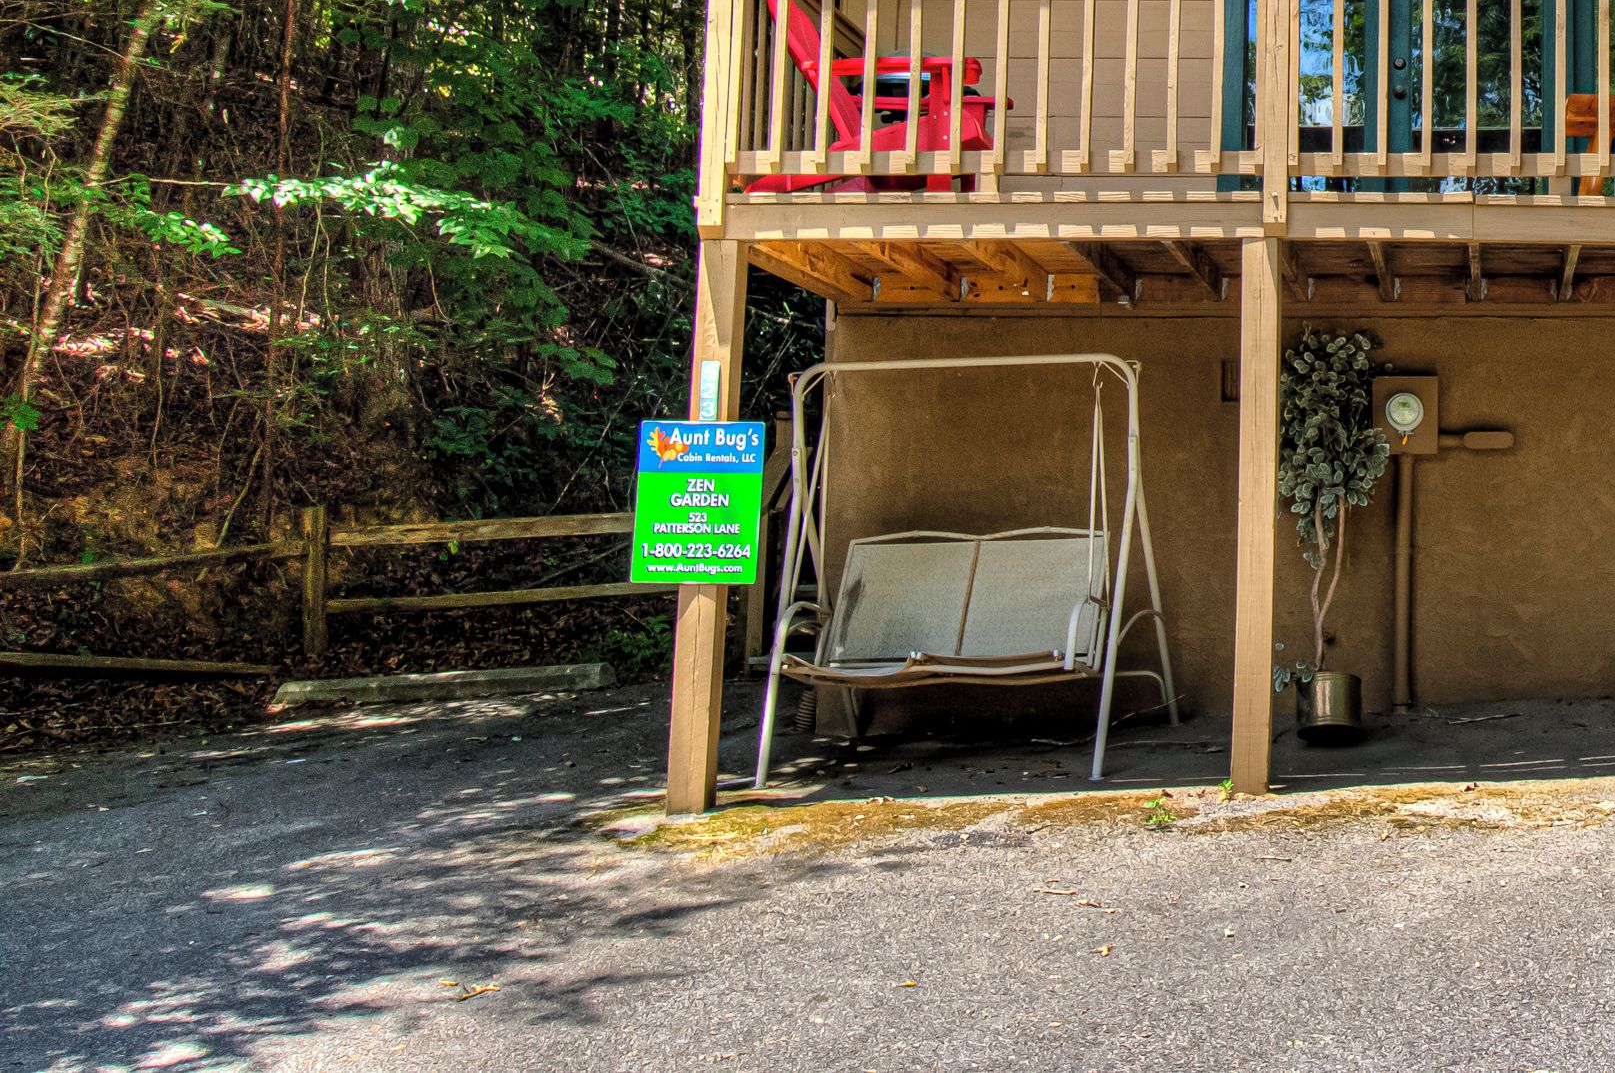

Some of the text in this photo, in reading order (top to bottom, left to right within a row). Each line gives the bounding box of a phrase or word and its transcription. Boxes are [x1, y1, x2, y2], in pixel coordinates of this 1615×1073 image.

[669, 427, 759, 451] Aunt Bug's
[677, 452, 757, 464] Cabin Rentals, LLC
[686, 478, 715, 493] ZEN
[670, 493, 730, 508] GARDEN
[688, 512, 708, 523] 523
[653, 523, 740, 534] PATTERSON LANE
[642, 542, 751, 559] 1-800-223-6264
[646, 562, 743, 575] www.AuntBugs.com
